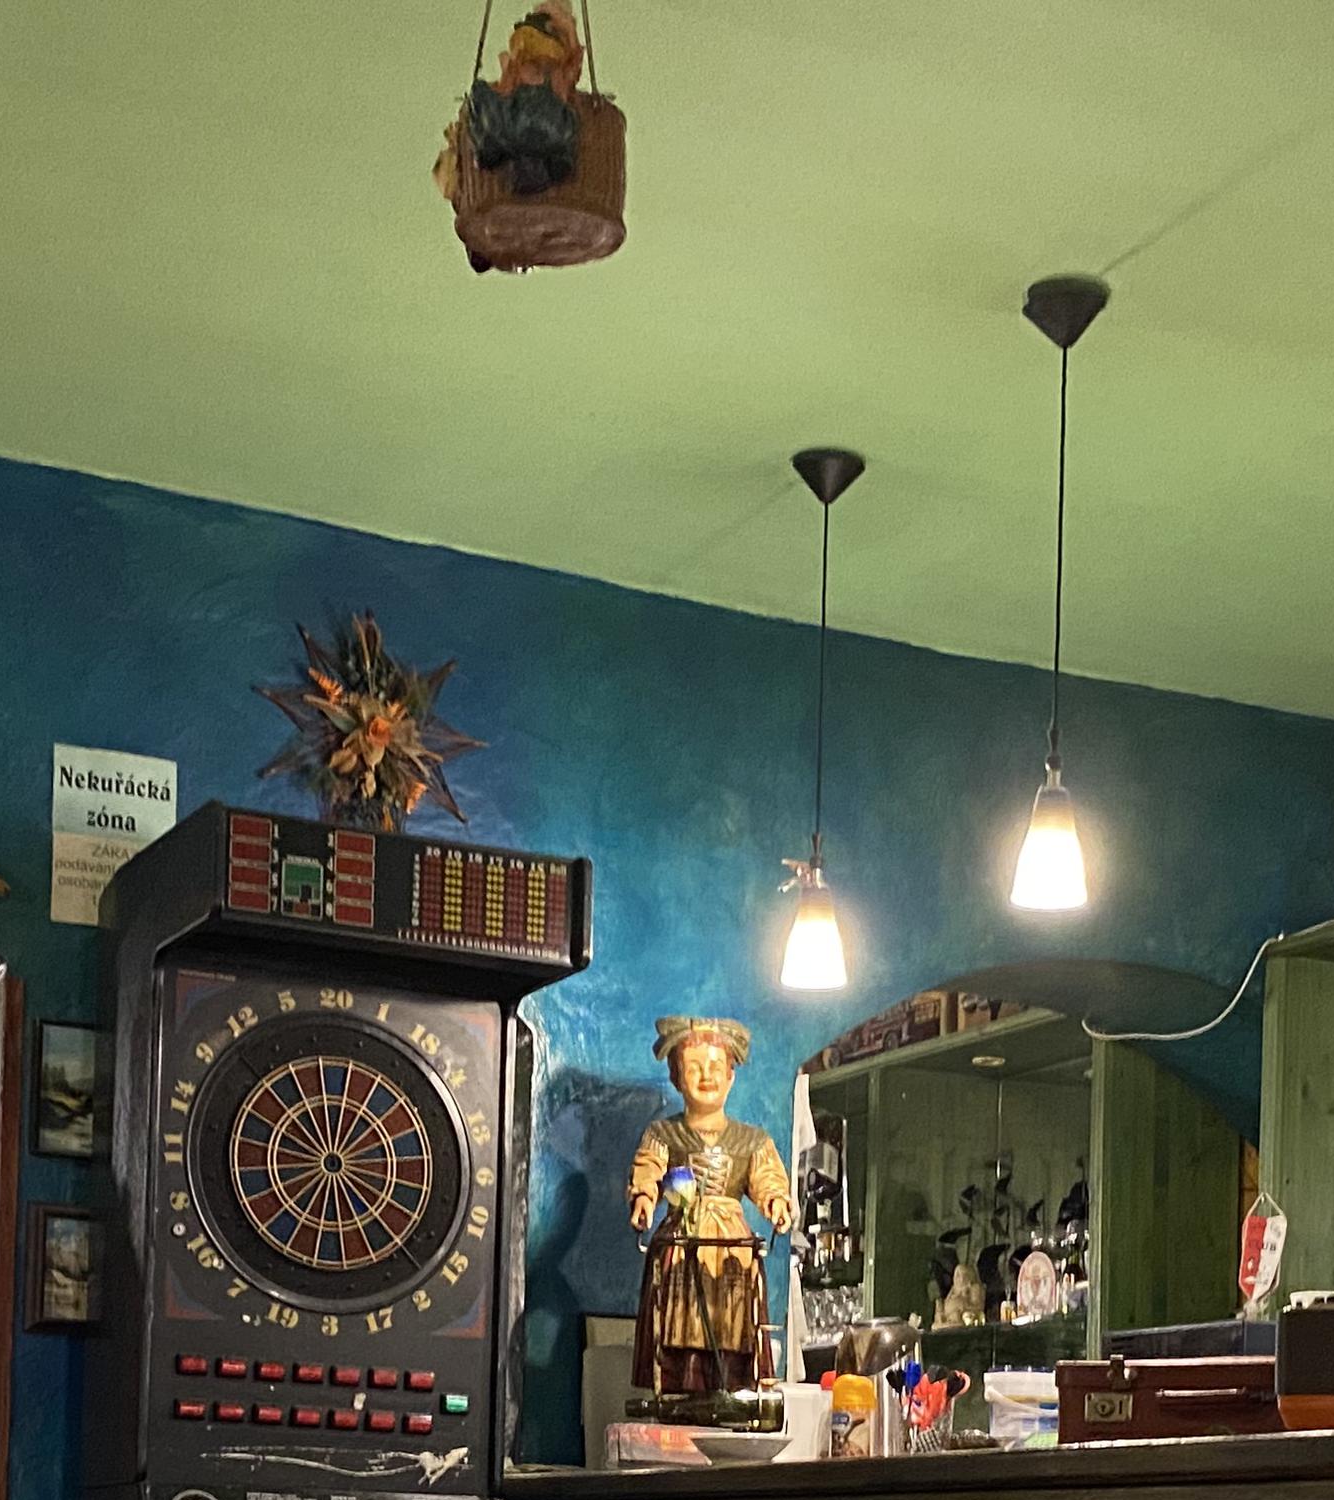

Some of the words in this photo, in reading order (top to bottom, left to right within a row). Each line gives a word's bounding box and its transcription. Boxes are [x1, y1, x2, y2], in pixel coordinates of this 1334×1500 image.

[59, 765, 171, 802] Nekuřácká
[86, 805, 137, 832] zóna
[91, 841, 131, 861] ZÁKA
[277, 990, 296, 1012] 5
[320, 989, 354, 1009] 20
[376, 1002, 390, 1022] 1
[226, 1006, 259, 1038] 12
[408, 1023, 441, 1055] 18
[196, 1042, 214, 1064] 9
[170, 1078, 196, 1115] 14
[164, 1133, 183, 1165] 11
[170, 1191, 190, 1210] 8
[467, 1205, 489, 1240] 10
[187, 1233, 220, 1269] 16
[439, 1250, 469, 1285] 15
[227, 1277, 249, 1298] 7
[412, 1289, 432, 1311] 2
[267, 1303, 299, 1329] 19
[321, 1314, 339, 1337] 3
[366, 1306, 394, 1334] 17
